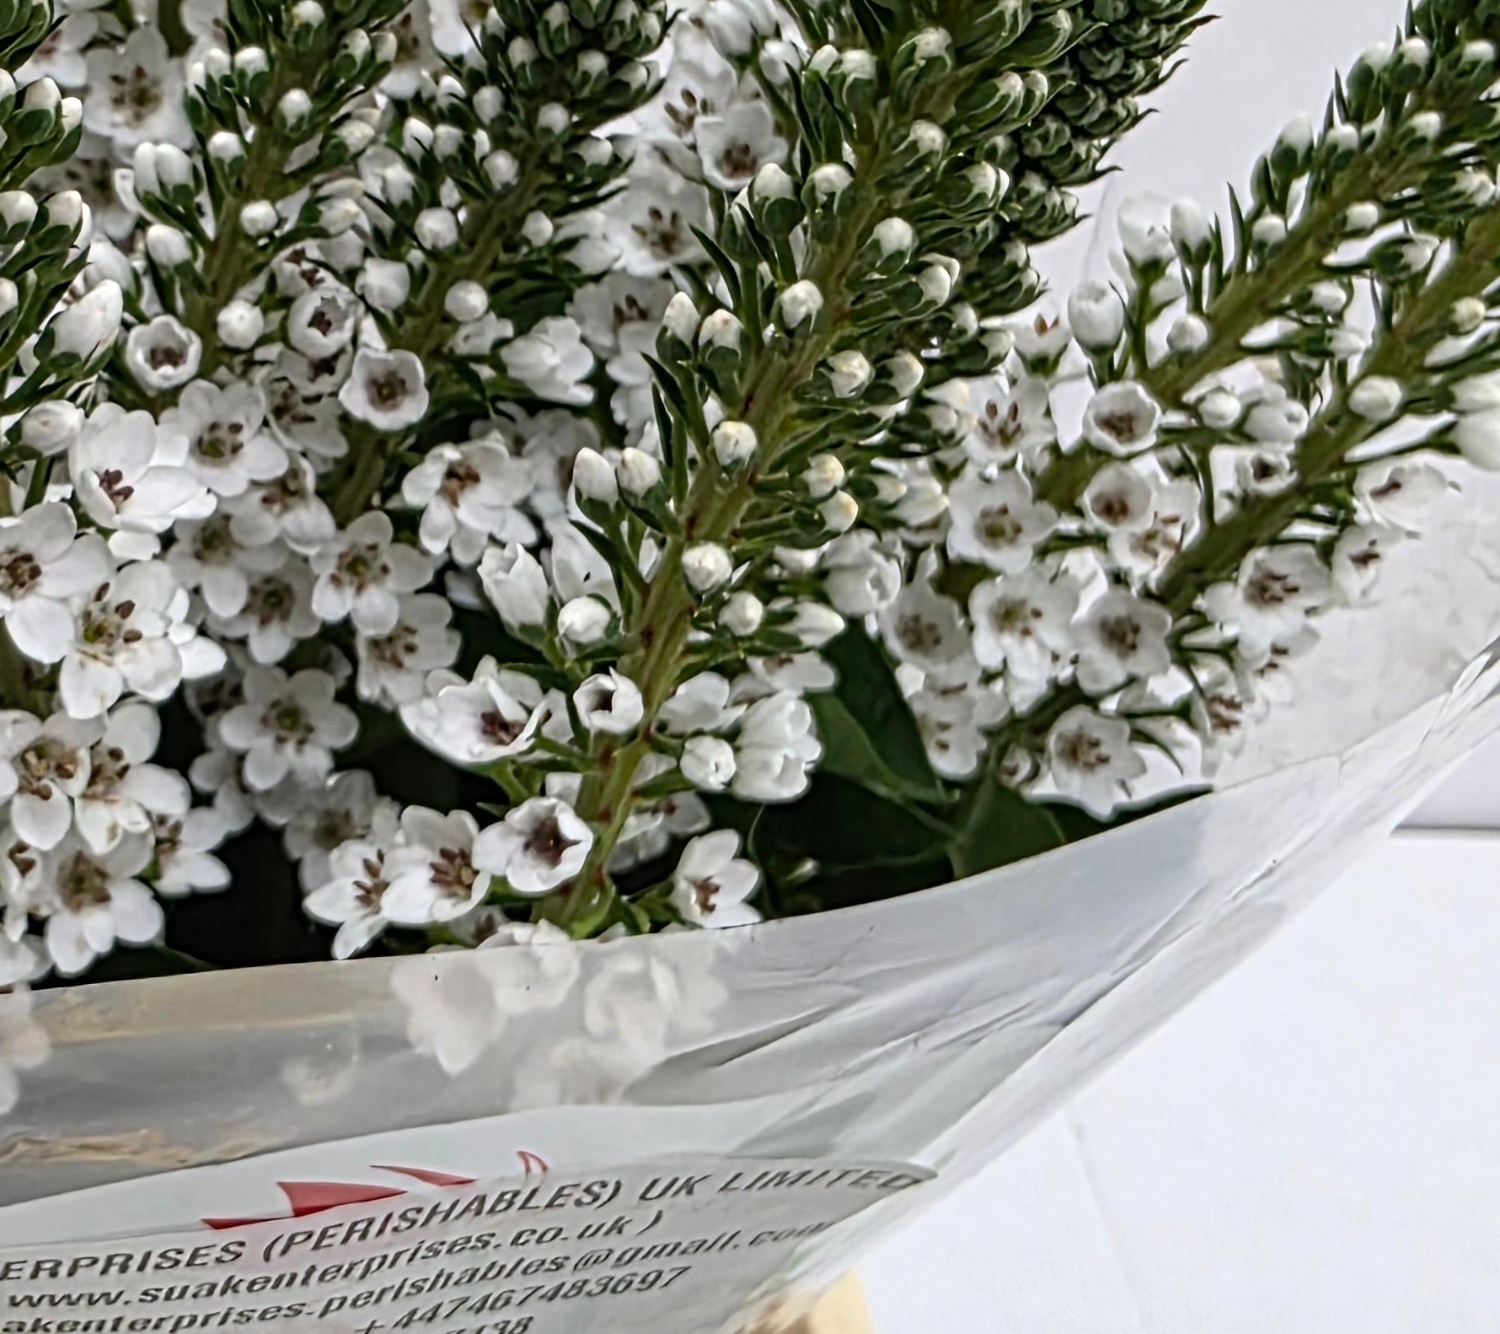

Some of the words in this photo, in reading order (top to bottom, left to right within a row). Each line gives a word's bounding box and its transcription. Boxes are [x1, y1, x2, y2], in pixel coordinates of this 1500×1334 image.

[8, 1215, 634, 1308] www.suakenterprises.co.uk
[262, 1179, 622, 1264] (PERISHABLES)
[639, 1173, 713, 1202] UK
[717, 1169, 924, 1194] LIMITED
